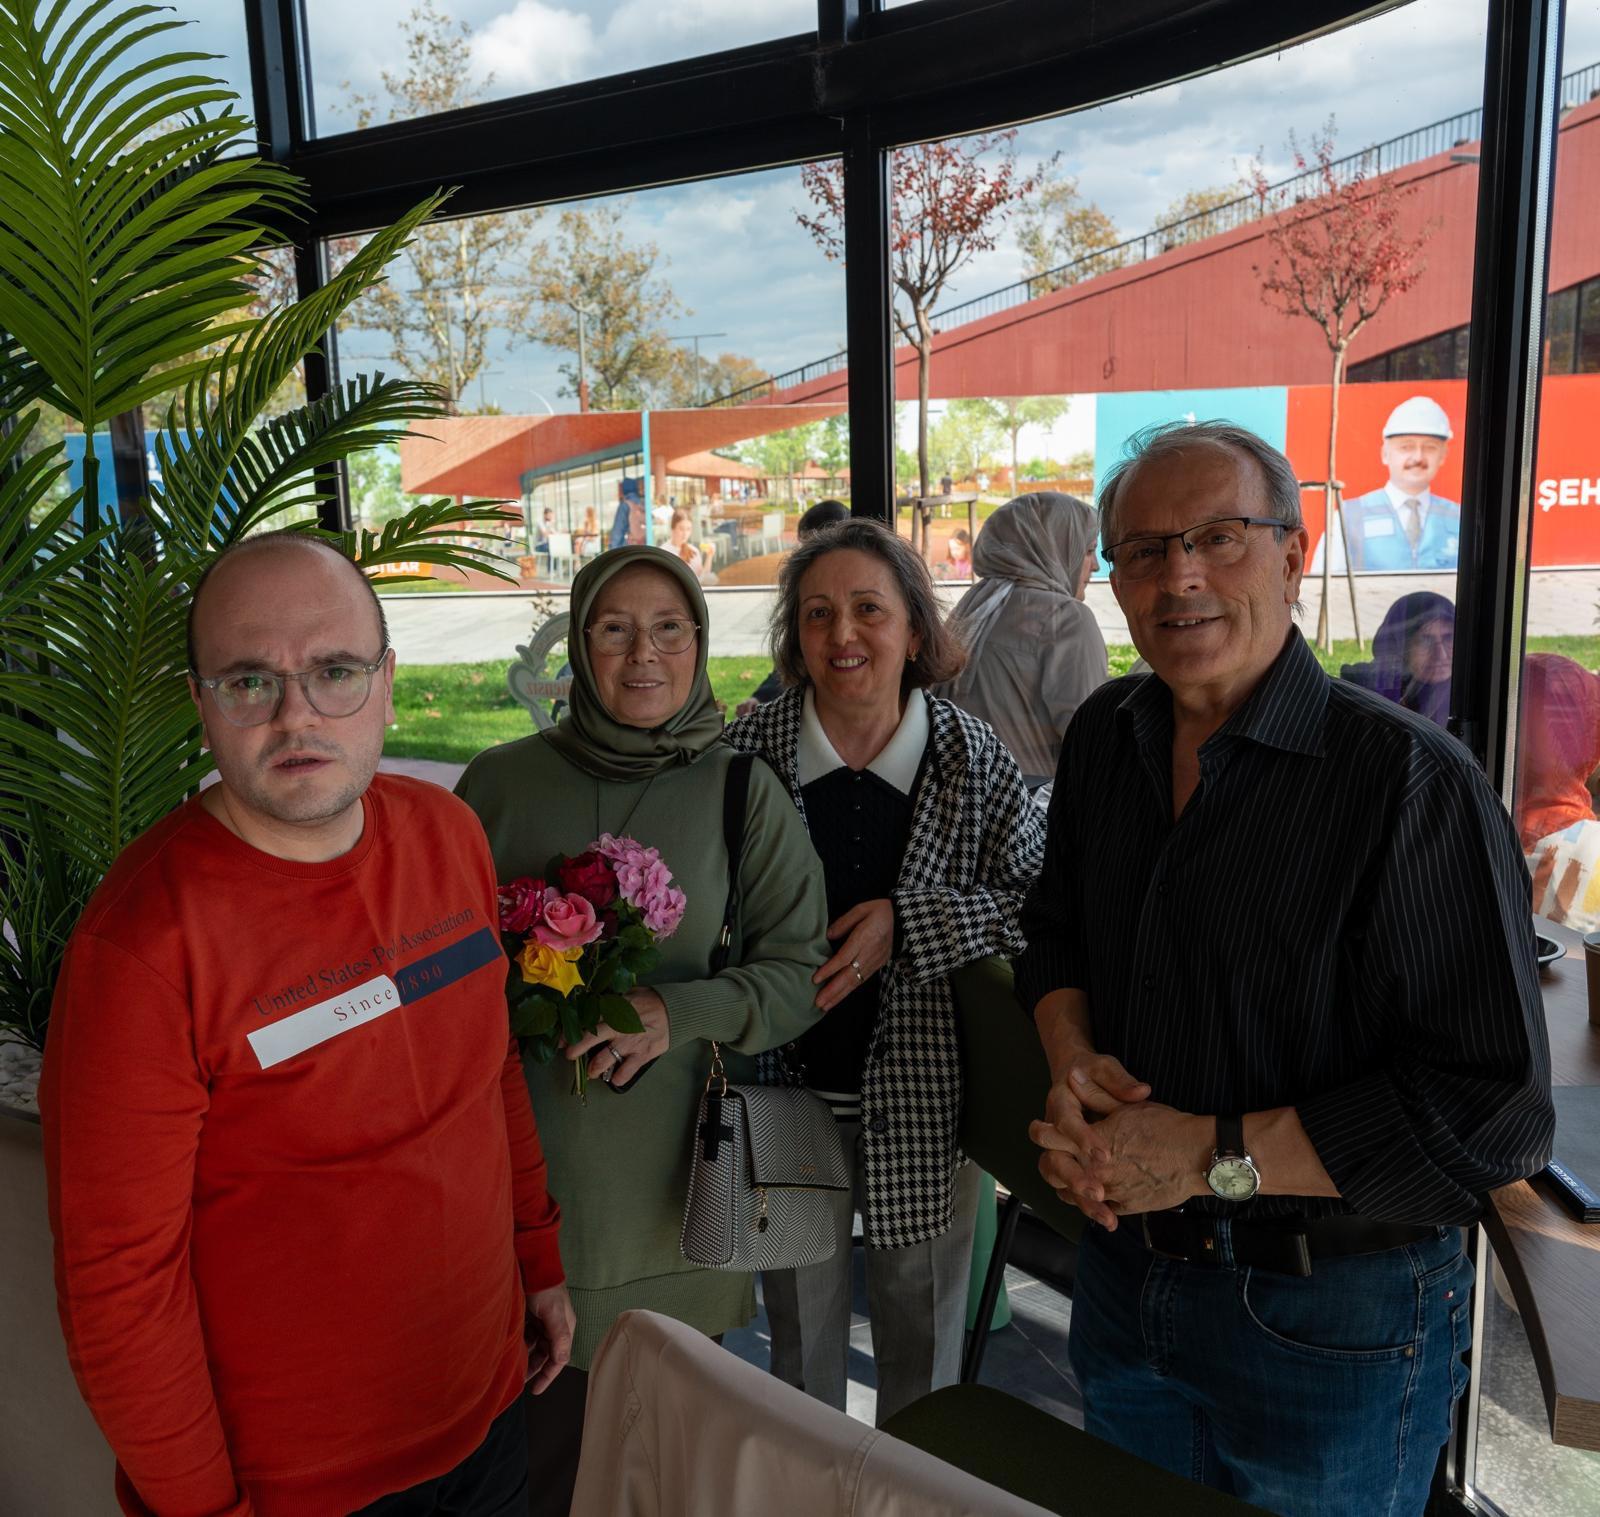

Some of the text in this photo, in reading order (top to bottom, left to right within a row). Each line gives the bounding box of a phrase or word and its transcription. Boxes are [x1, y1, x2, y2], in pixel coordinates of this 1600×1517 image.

[1537, 478, 1600, 513] ŞEH
[253, 974, 319, 1017] United
[318, 957, 374, 991] States
[399, 908, 475, 954] Association
[333, 963, 443, 1022] Since 1890
